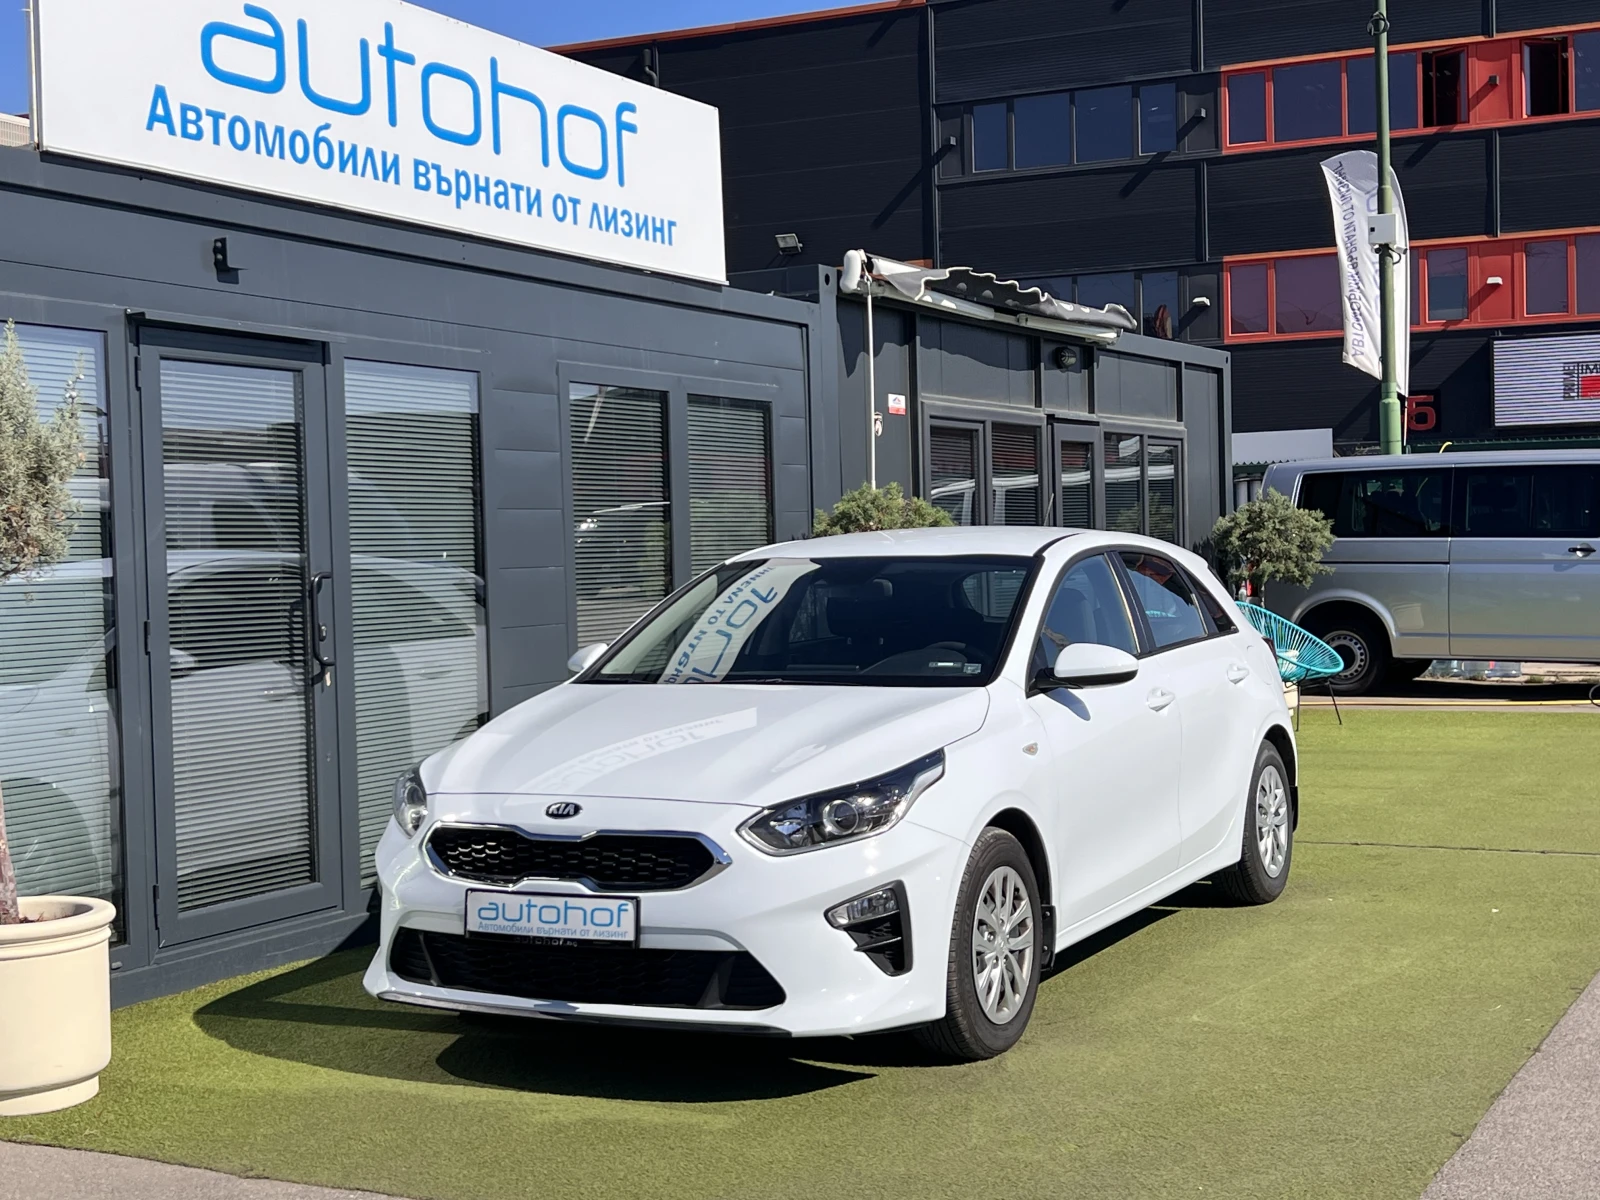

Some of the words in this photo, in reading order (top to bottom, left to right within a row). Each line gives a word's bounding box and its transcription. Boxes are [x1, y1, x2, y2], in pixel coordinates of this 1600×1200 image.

[199, 2, 639, 188] autohof
[146, 84, 401, 186] Автомобили
[413, 157, 543, 218] върнати
[552, 193, 582, 226] от
[589, 201, 677, 246] лизинг
[548, 803, 576, 815] KIA
[478, 898, 629, 928] autohof
[478, 921, 533, 934] Автомобили
[537, 926, 577, 936] върнати
[580, 928, 590, 937] от
[593, 929, 628, 939] лизинг
